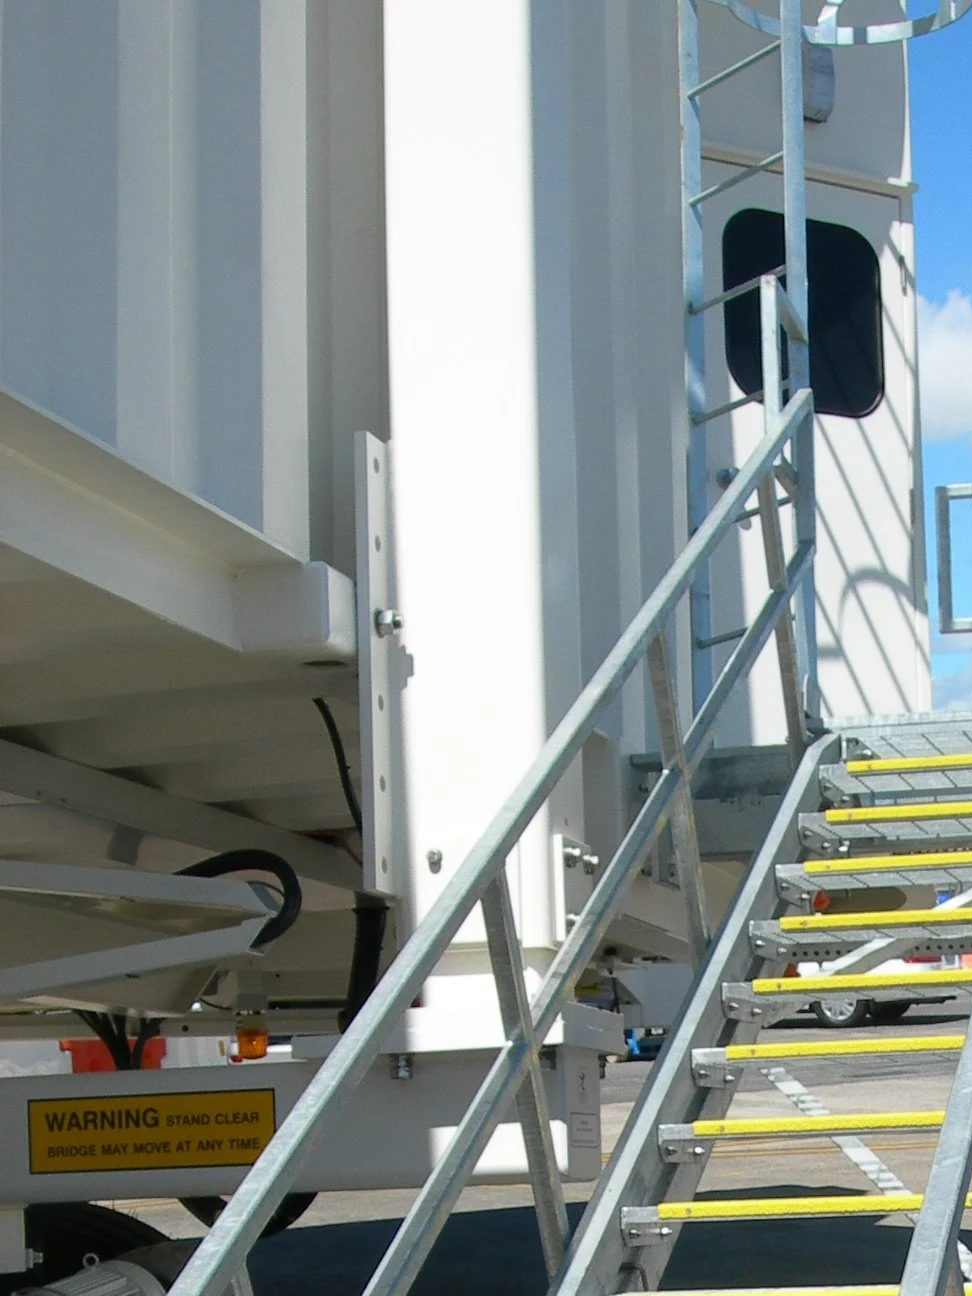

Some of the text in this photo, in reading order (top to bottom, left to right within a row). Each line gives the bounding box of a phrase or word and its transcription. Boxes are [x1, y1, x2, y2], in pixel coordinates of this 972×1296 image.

[44, 1107, 260, 1133] WARNING STAND CLEAR
[47, 1137, 260, 1159] BRIDGE MAY MOVE AT ANY TIME
